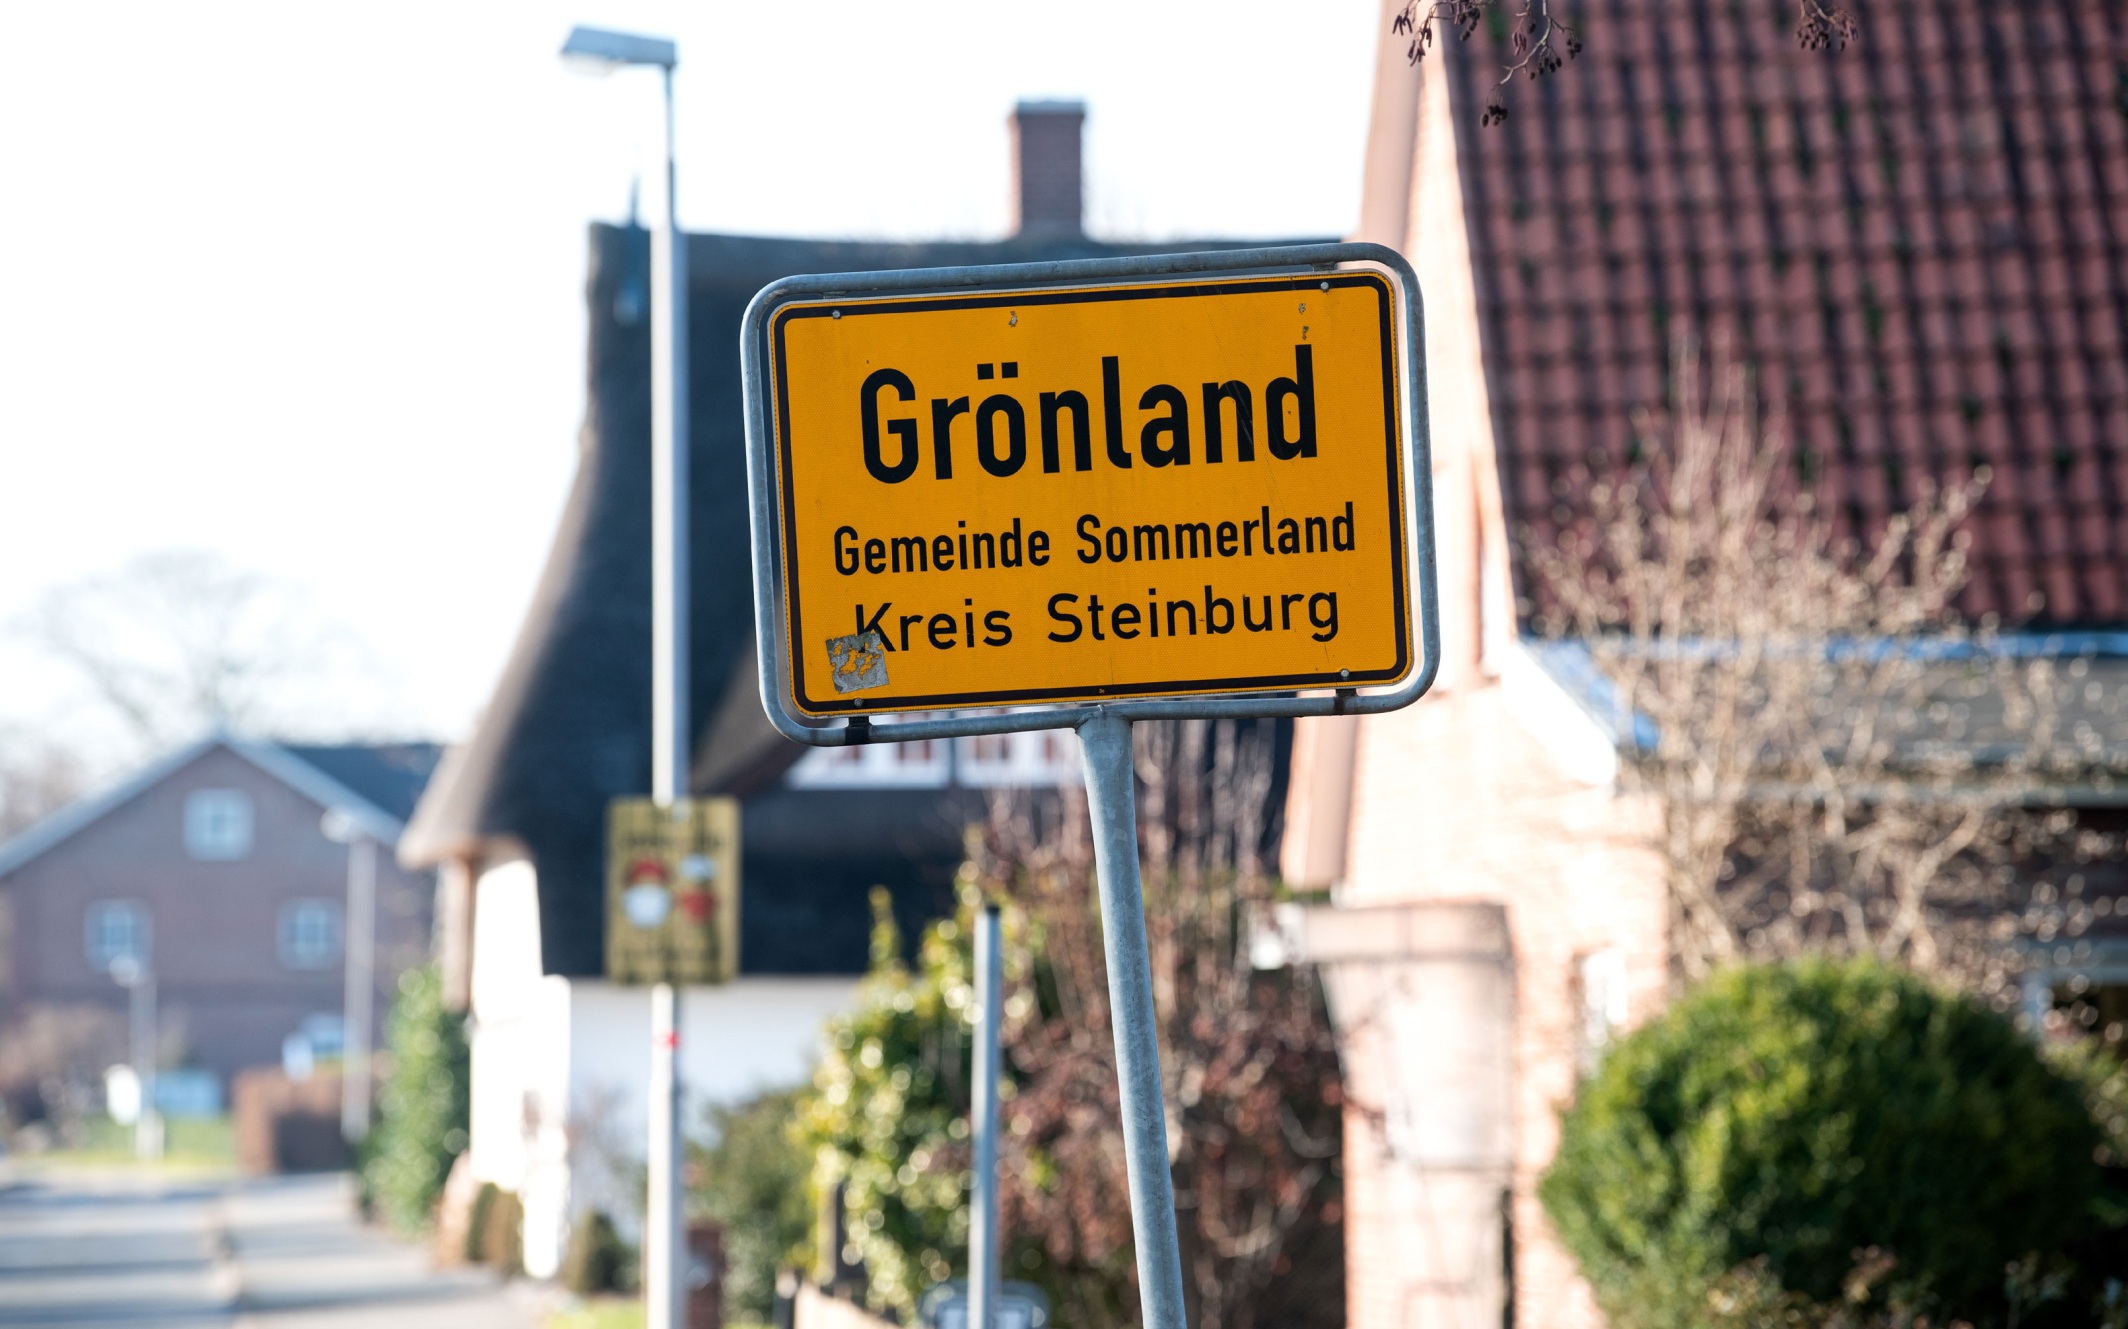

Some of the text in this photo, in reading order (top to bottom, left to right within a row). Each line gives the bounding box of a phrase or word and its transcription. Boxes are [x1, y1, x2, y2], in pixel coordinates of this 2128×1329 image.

[860, 343, 1319, 485] Grönland
[833, 501, 1356, 576] Gemeinde Sommerland
[855, 584, 1340, 653] Kreis Steinburg
